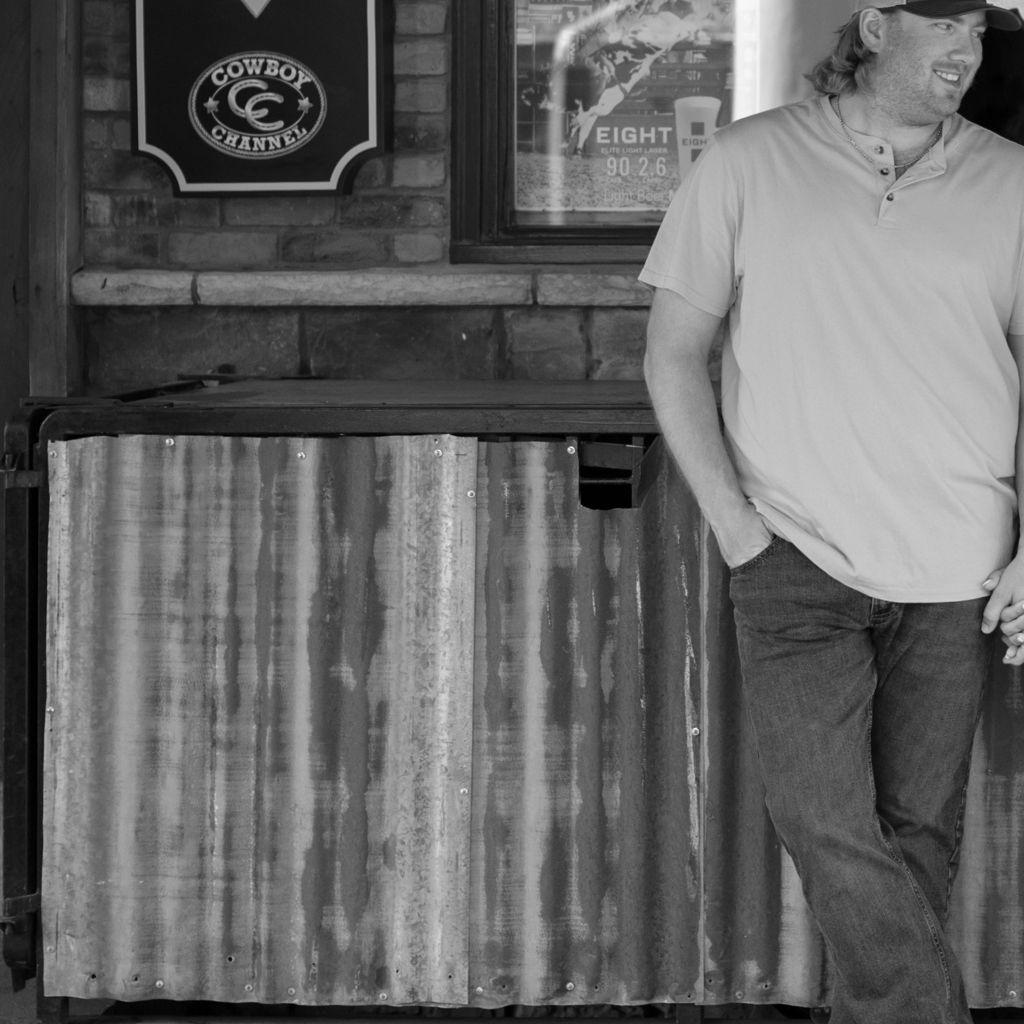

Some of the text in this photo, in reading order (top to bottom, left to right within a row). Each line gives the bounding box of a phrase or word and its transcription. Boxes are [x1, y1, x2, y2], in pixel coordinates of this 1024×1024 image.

[211, 58, 312, 90] COWBOY
[211, 124, 307, 152] CHANNEL
[596, 126, 673, 143] EIGHT
[682, 138, 708, 146] EIGH
[606, 156, 667, 176] 90 2.6
